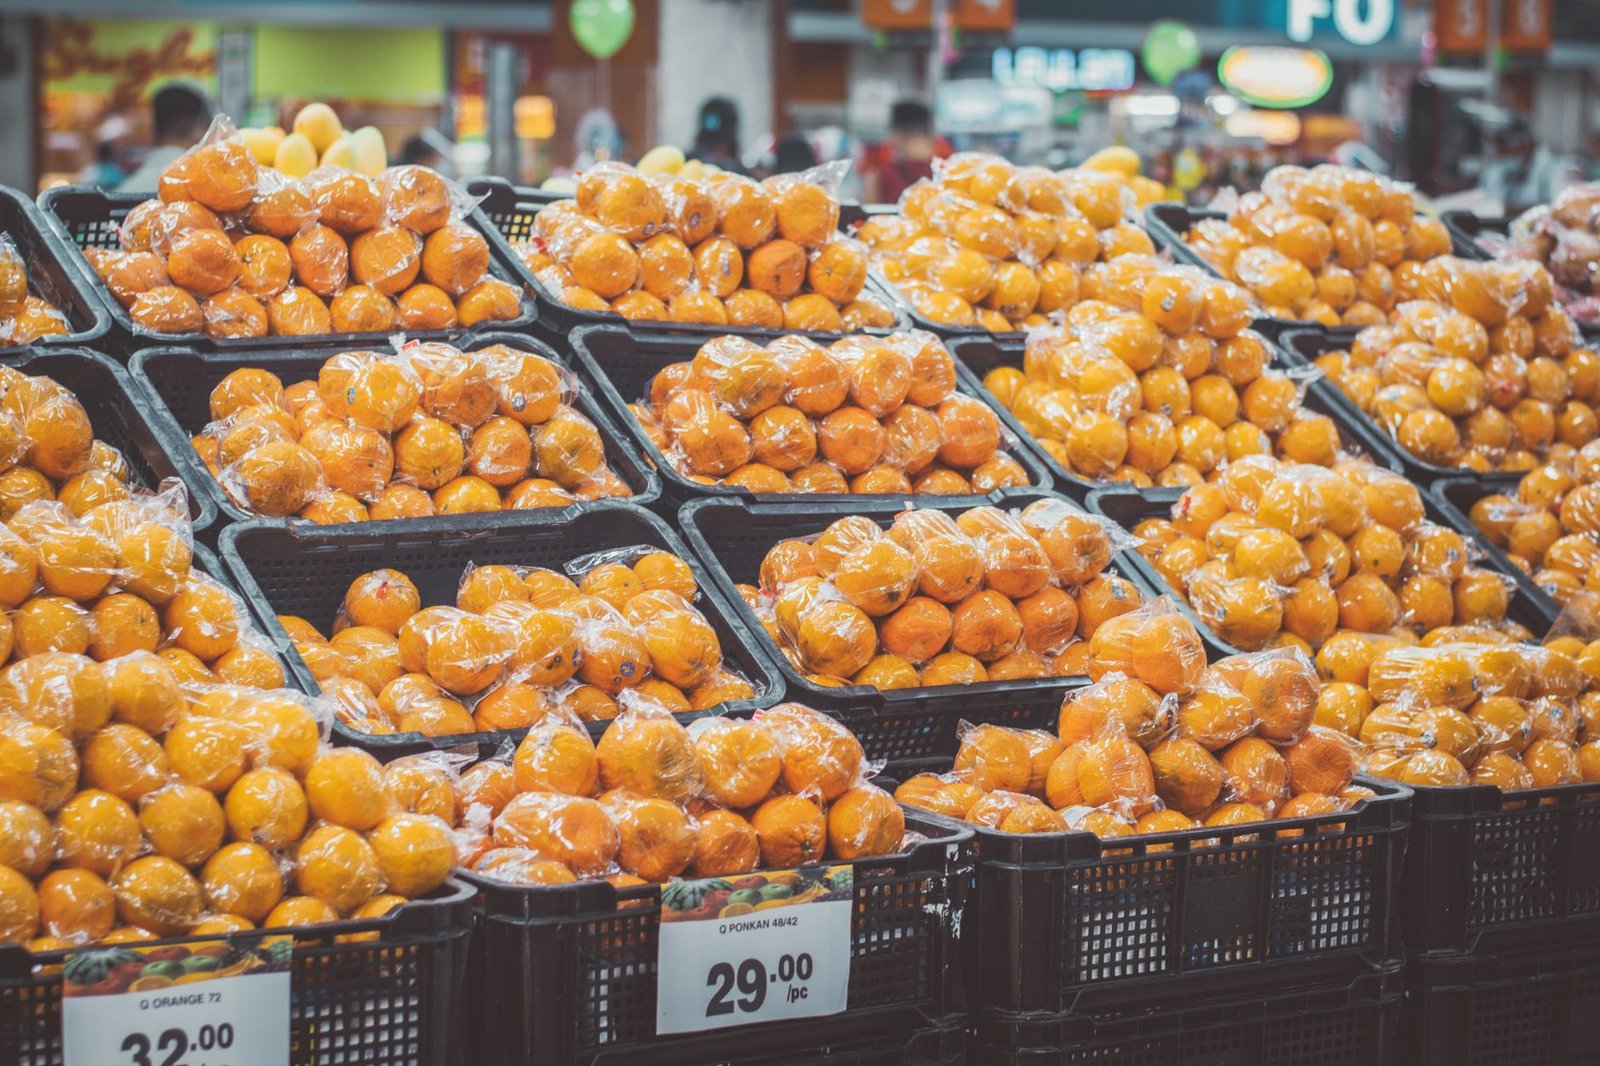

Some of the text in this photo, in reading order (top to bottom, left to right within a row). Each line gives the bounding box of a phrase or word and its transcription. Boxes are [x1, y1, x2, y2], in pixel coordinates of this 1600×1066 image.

[719, 917, 798, 934] Q PONKAN 48/42
[152, 993, 204, 1009] ORANGE
[208, 992, 222, 1003] 72
[786, 984, 808, 1003] /pc
